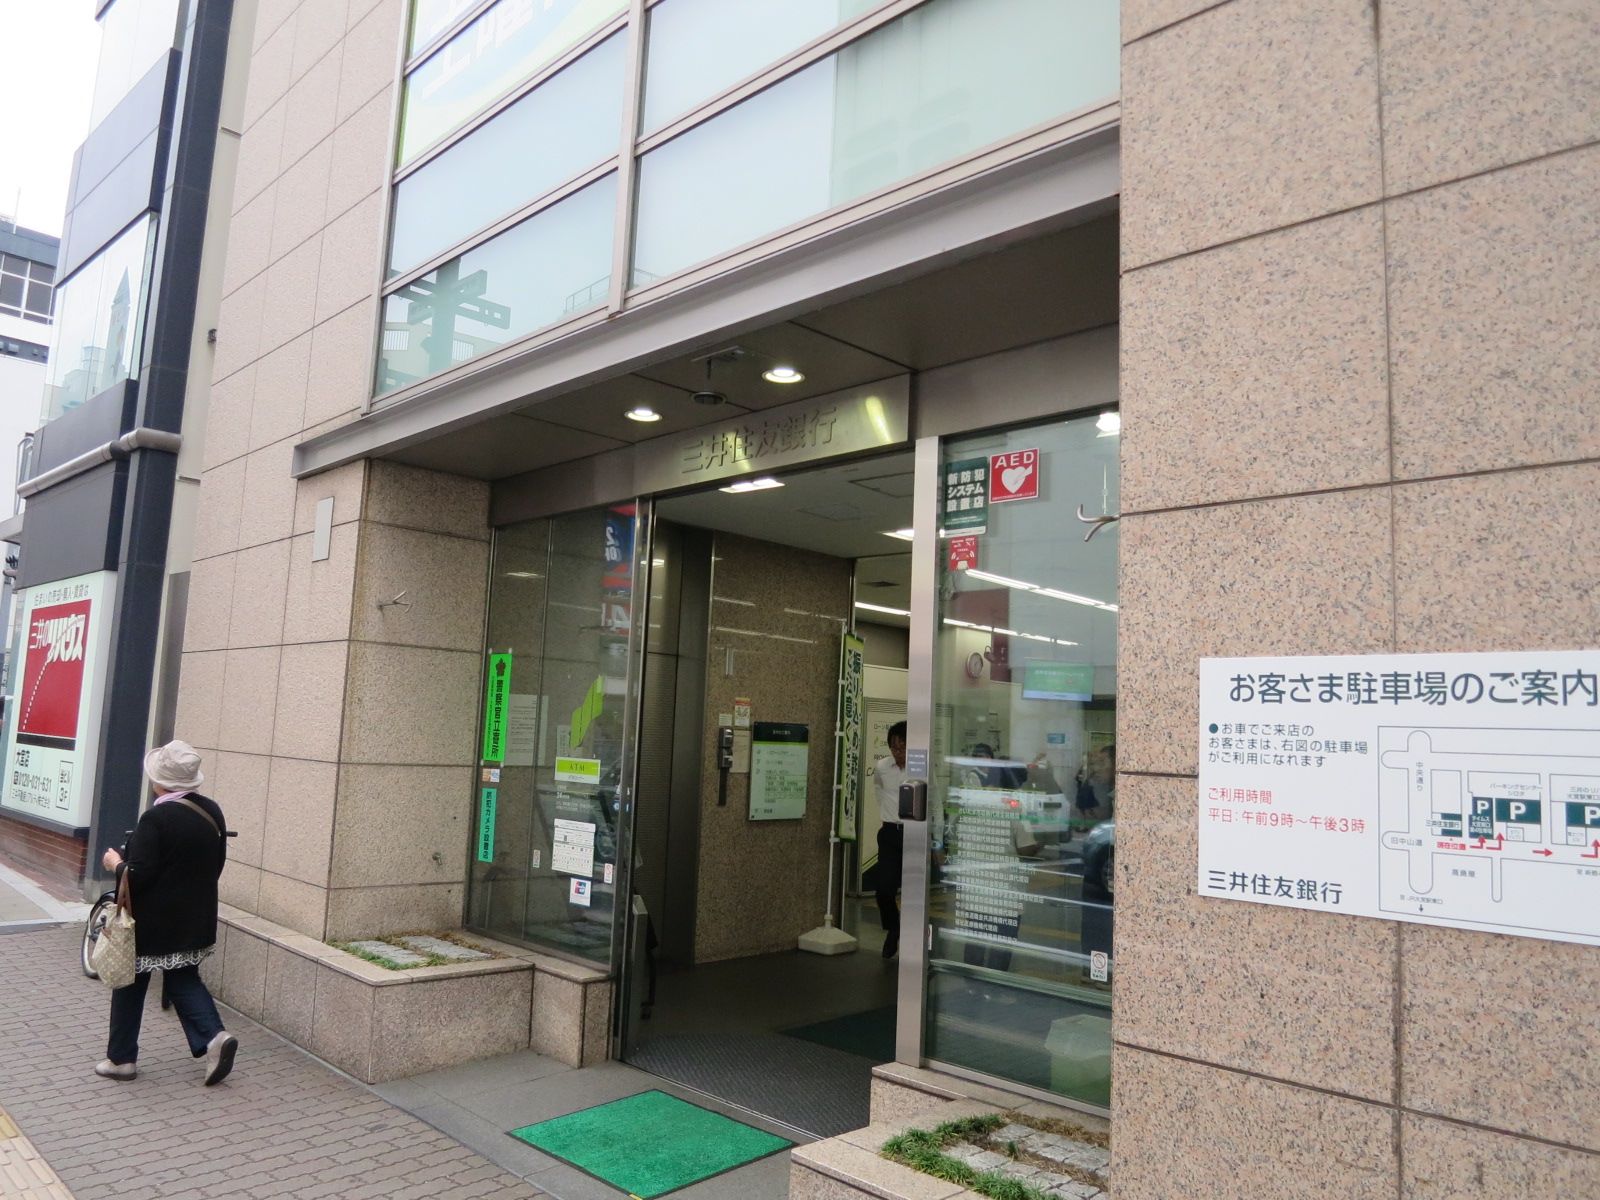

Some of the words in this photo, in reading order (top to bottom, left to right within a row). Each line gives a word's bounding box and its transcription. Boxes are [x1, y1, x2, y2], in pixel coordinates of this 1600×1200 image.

[681, 407, 837, 474] 三井住友銀行
[995, 451, 1035, 469] AED
[947, 468, 985, 485] 新防犯
[948, 482, 984, 499] システム
[946, 496, 984, 513] 設置店
[1229, 669, 1599, 707] お客さま駐車場のご案内
[1221, 723, 1315, 737] お車でご来店の
[1208, 737, 1369, 755] お客さまは、右図の駐車場
[569, 763, 586, 772] ATM
[1208, 751, 1326, 768] がご利用になれます
[1208, 787, 1273, 805] ご利用時間
[1476, 800, 1490, 815] P
[1509, 801, 1527, 820] P
[1584, 806, 1600, 825] P
[1207, 870, 1343, 905] 三井住友銀行
